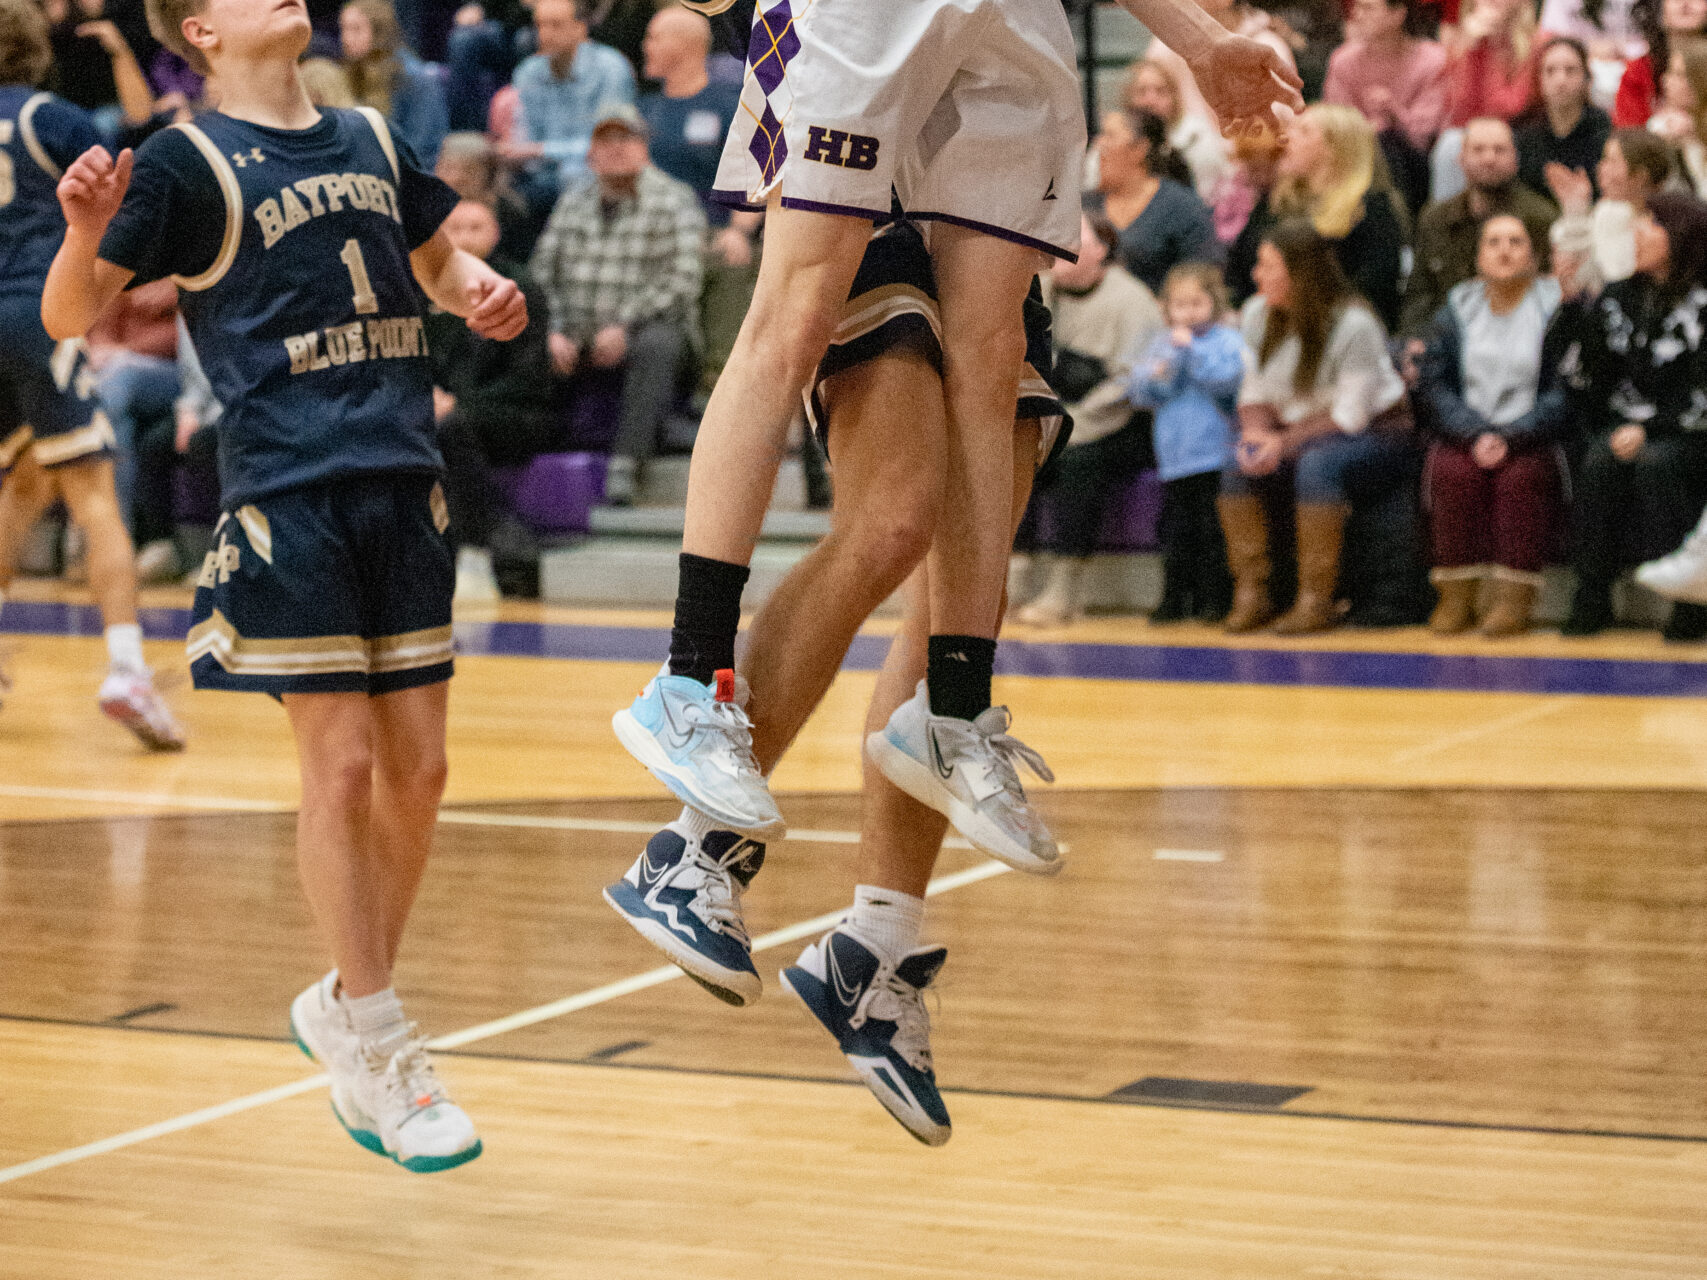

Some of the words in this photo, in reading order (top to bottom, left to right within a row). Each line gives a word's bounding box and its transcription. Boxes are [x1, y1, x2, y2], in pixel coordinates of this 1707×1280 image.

[803, 125, 880, 171] HB
[253, 172, 402, 249] BAYPORT
[340, 238, 379, 314] 1
[284, 321, 367, 375] BLUE
[366, 317, 430, 360] POINT
